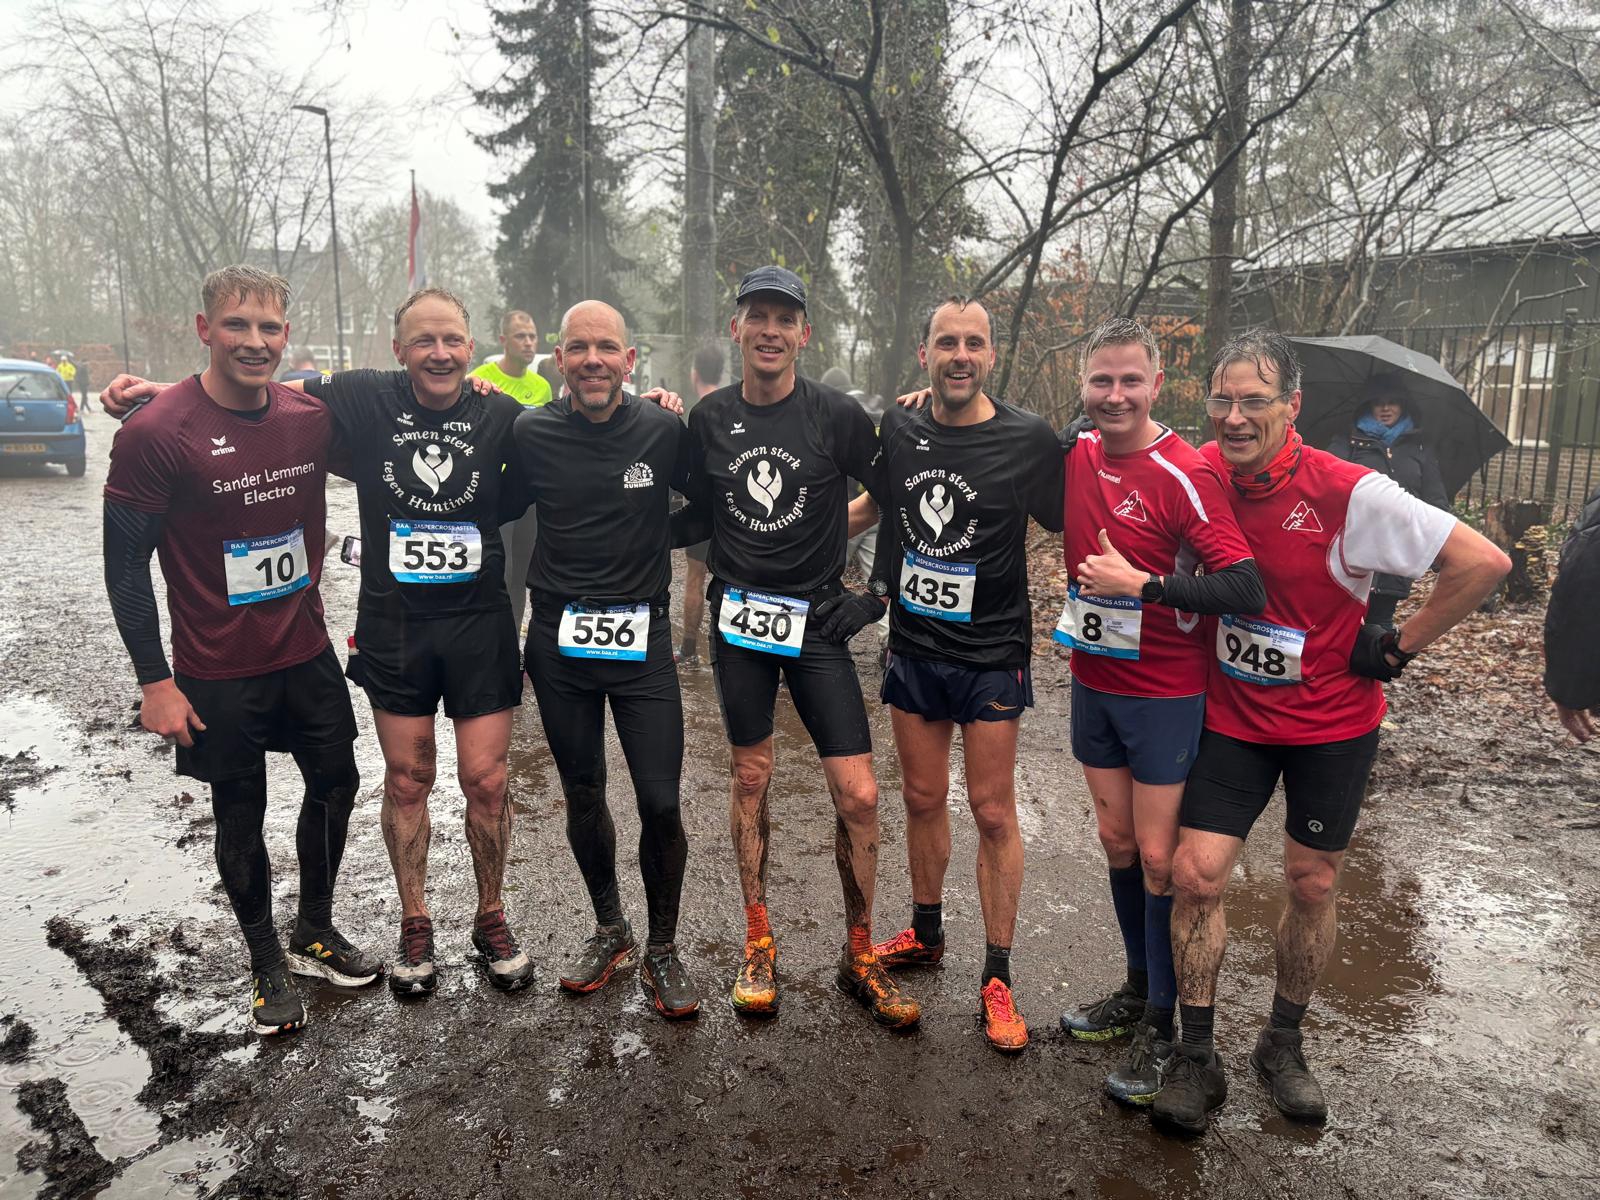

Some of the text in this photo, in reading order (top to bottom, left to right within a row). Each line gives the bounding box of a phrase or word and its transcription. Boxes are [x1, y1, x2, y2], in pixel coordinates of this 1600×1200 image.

[442, 421, 472, 432] #CTH
[211, 446, 236, 456] erima
[392, 430, 474, 456] Samen sterk
[728, 446, 801, 474] Samen sterk
[212, 462, 315, 494] Sander Lemmen
[382, 461, 480, 512] tegen Huntington
[623, 481, 654, 489] RUNNING
[904, 468, 978, 502] Samen sterk
[243, 485, 296, 506] Electro
[725, 486, 808, 532] tegen Huntington
[916, 518, 979, 557] Huntington
[255, 552, 294, 586] 10
[403, 541, 468, 570] 553
[915, 556, 950, 571] JASPERCROSS
[260, 586, 292, 597] www.baa.nl
[904, 573, 960, 609] 435
[730, 606, 792, 642] 430
[912, 605, 942, 616] www.baa.nl
[572, 616, 635, 647] 556
[1082, 612, 1102, 642] 8
[742, 639, 773, 649] www.baa.nl
[1075, 642, 1107, 652] www.baa.nl
[1225, 633, 1286, 676] 948
